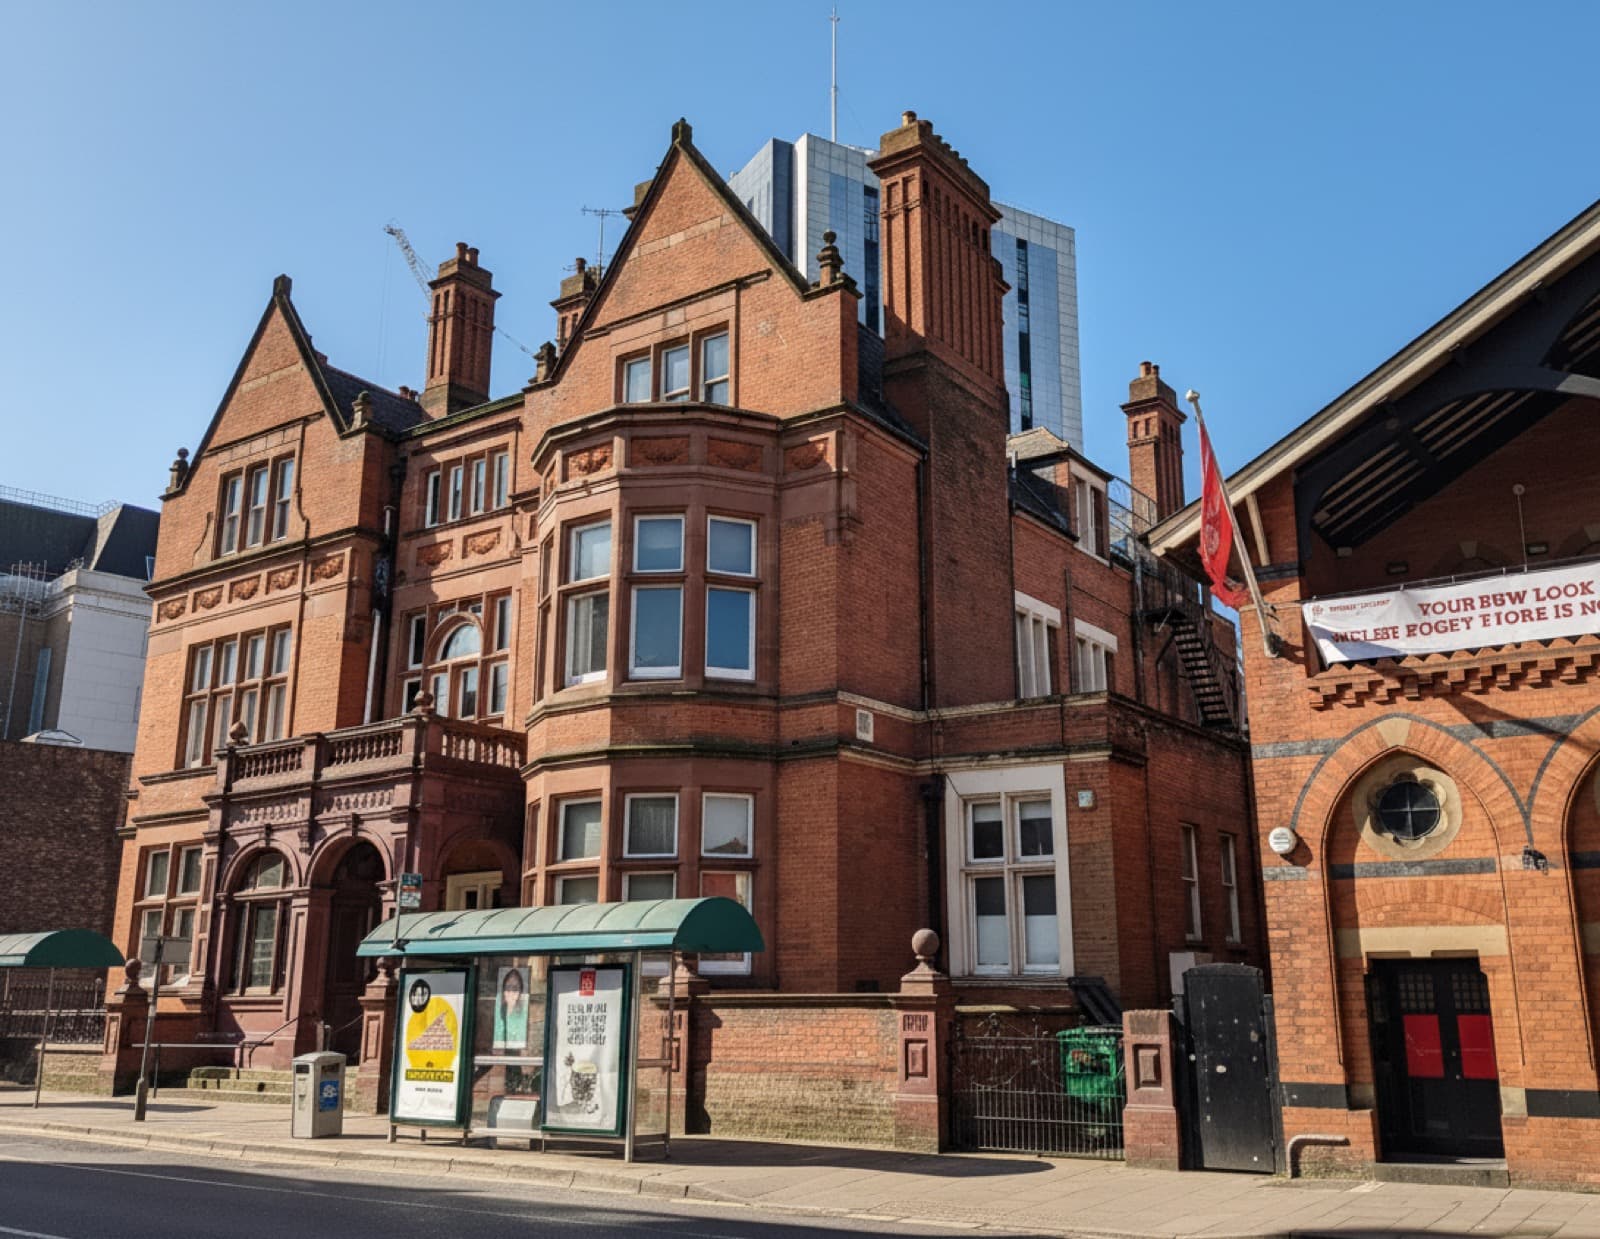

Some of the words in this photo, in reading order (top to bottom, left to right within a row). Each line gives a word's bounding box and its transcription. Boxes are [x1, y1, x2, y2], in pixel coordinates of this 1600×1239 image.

[1418, 597, 1476, 616] YOUR
[1532, 580, 1595, 602] LOOK
[1553, 602, 1573, 619] IS
